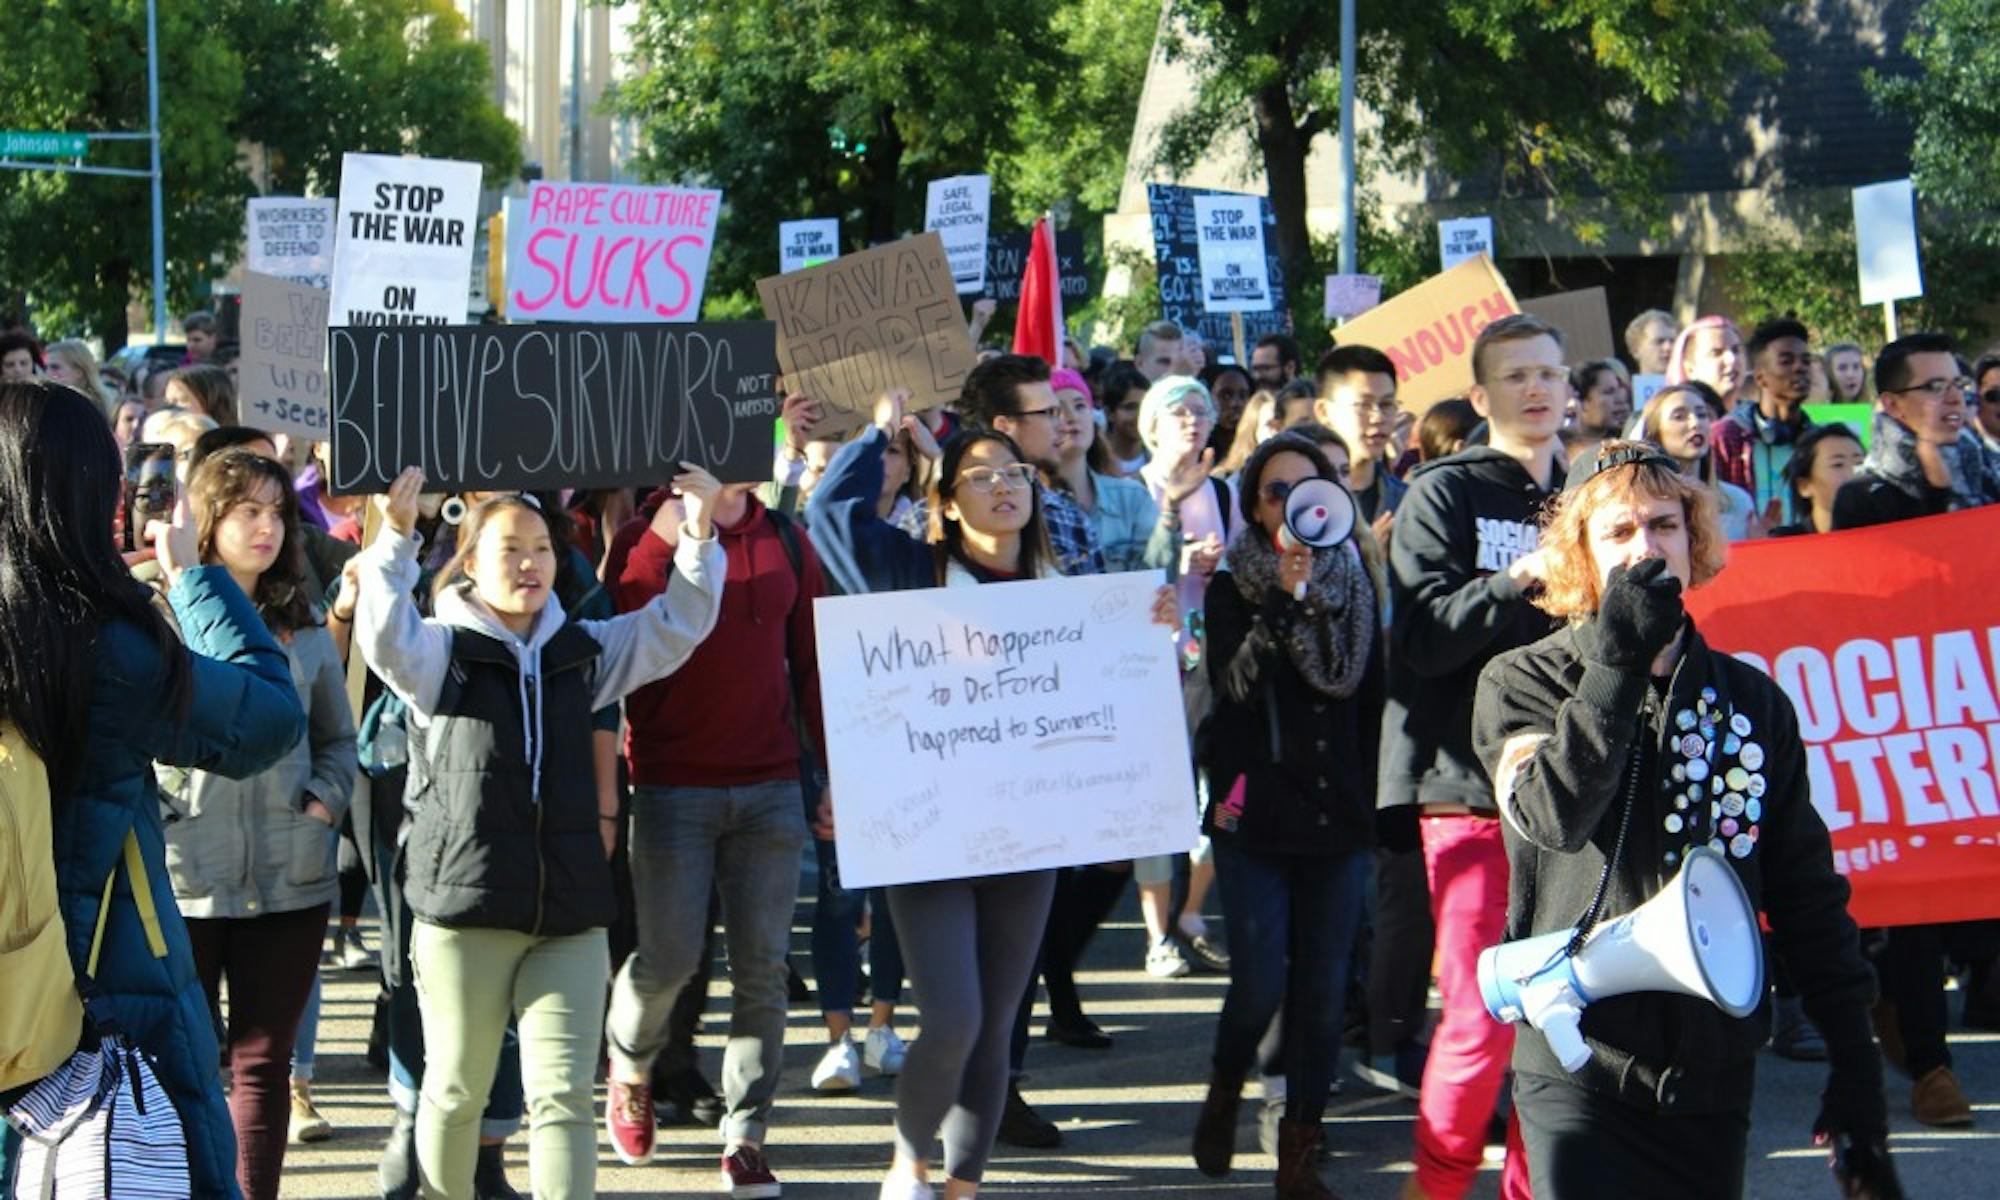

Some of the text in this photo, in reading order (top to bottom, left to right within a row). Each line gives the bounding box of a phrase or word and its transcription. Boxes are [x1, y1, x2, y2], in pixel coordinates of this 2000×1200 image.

[3, 134, 59, 153] Johnson
[374, 182, 444, 213] STOP
[530, 185, 718, 228] RAPE CULTURE
[939, 200, 974, 216] LEGAL
[256, 207, 328, 223] WORKERS
[930, 213, 984, 230] ABORTION
[1211, 209, 1244, 225] STOP
[259, 223, 325, 240] UNITE TO
[349, 211, 465, 247] THE WAR
[794, 231, 823, 246] STOP
[1203, 225, 1258, 241] THE WAR
[1452, 229, 1478, 243] STOP
[264, 241, 319, 257] DEFEND
[785, 243, 834, 258] THE WAR
[1445, 241, 1488, 255] THE WAR
[514, 228, 705, 317] SUCKS
[1225, 263, 1242, 276] ON
[1212, 278, 1259, 292] WOMEN!
[383, 286, 416, 312] ON
[1388, 290, 1515, 383] NOUGH
[788, 299, 967, 421] NOPE
[736, 373, 772, 395] NOT
[513, 330, 734, 475] SURVIVORS
[857, 620, 1085, 677] What happened
[928, 681, 952, 707] to
[1735, 626, 2000, 744] OCIA
[905, 715, 1001, 760] happened
[1009, 716, 1028, 738] to
[1805, 722, 2000, 833] LTER
[1833, 838, 1899, 875] ggle
